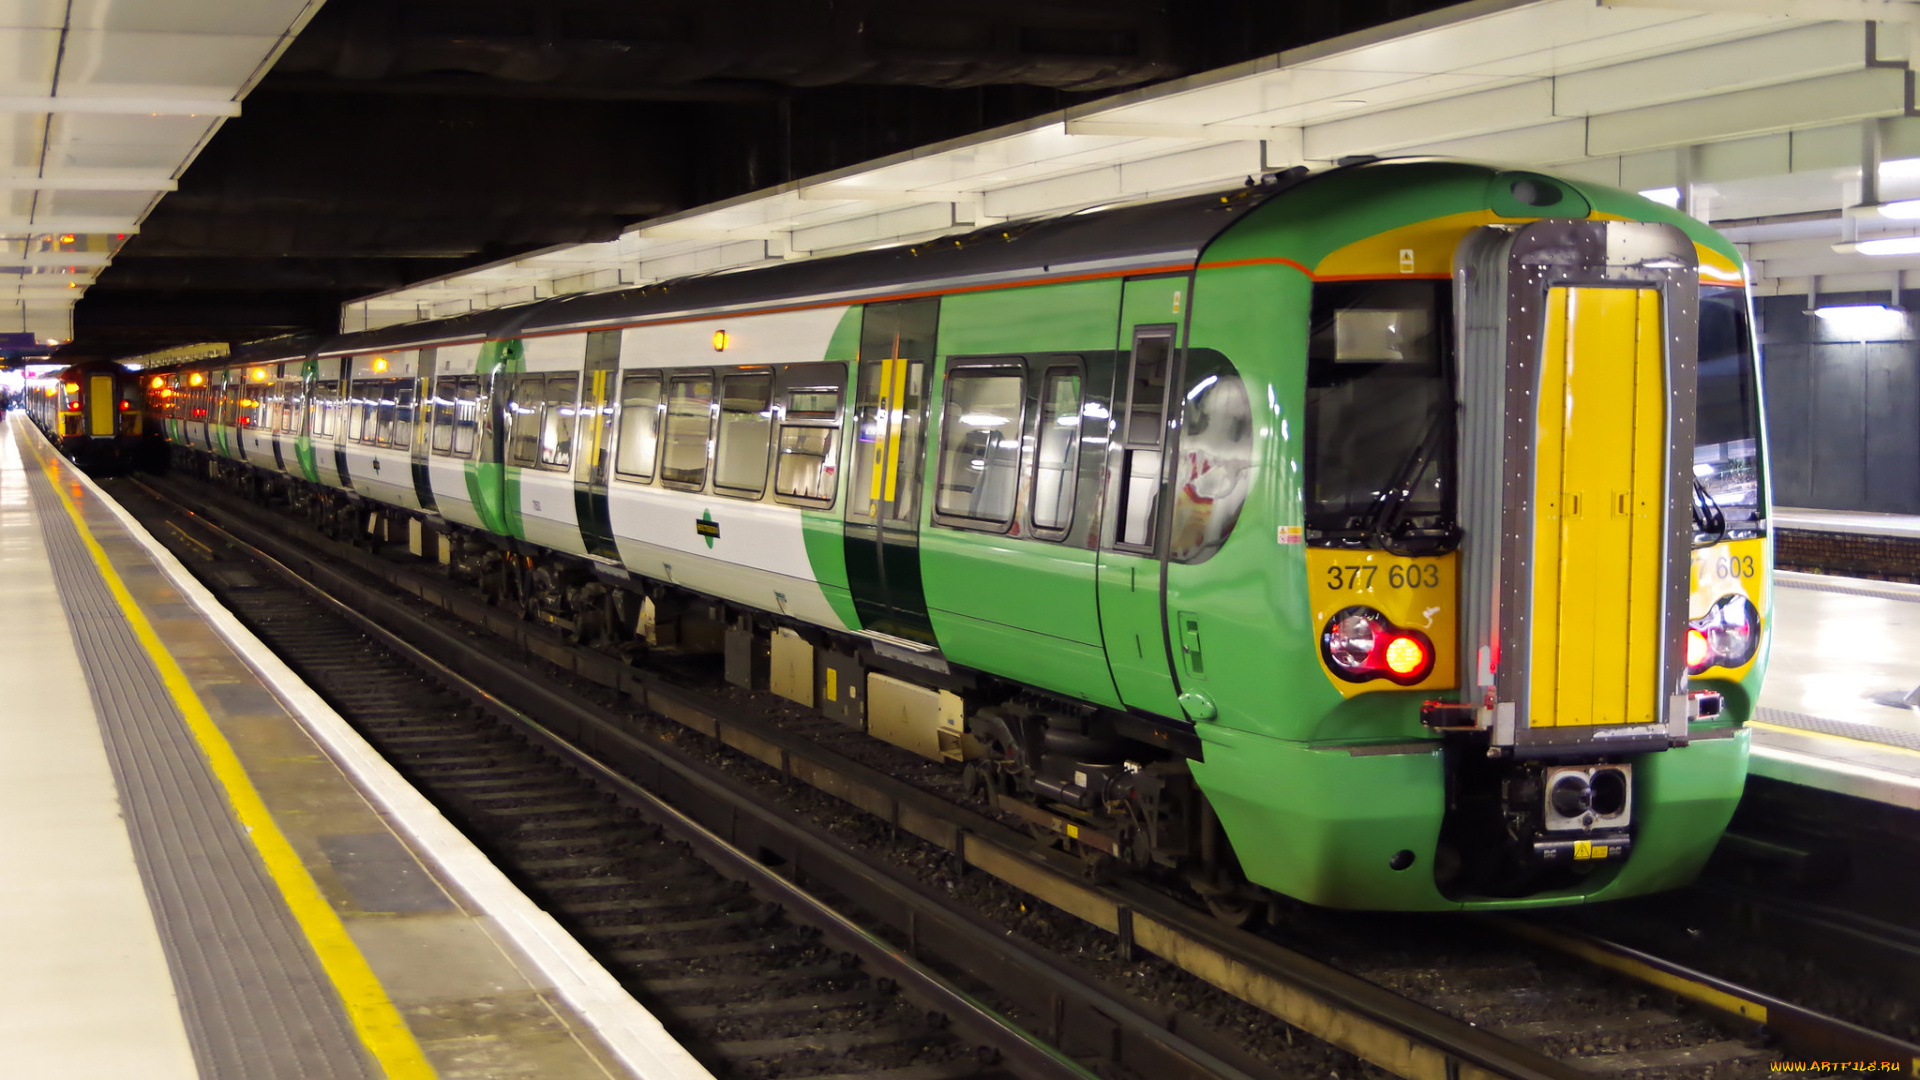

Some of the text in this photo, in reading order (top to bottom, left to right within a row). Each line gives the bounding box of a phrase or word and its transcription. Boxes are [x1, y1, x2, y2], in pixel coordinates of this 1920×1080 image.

[1327, 564, 1439, 590] 377 603
[1716, 555, 1755, 579] 603
